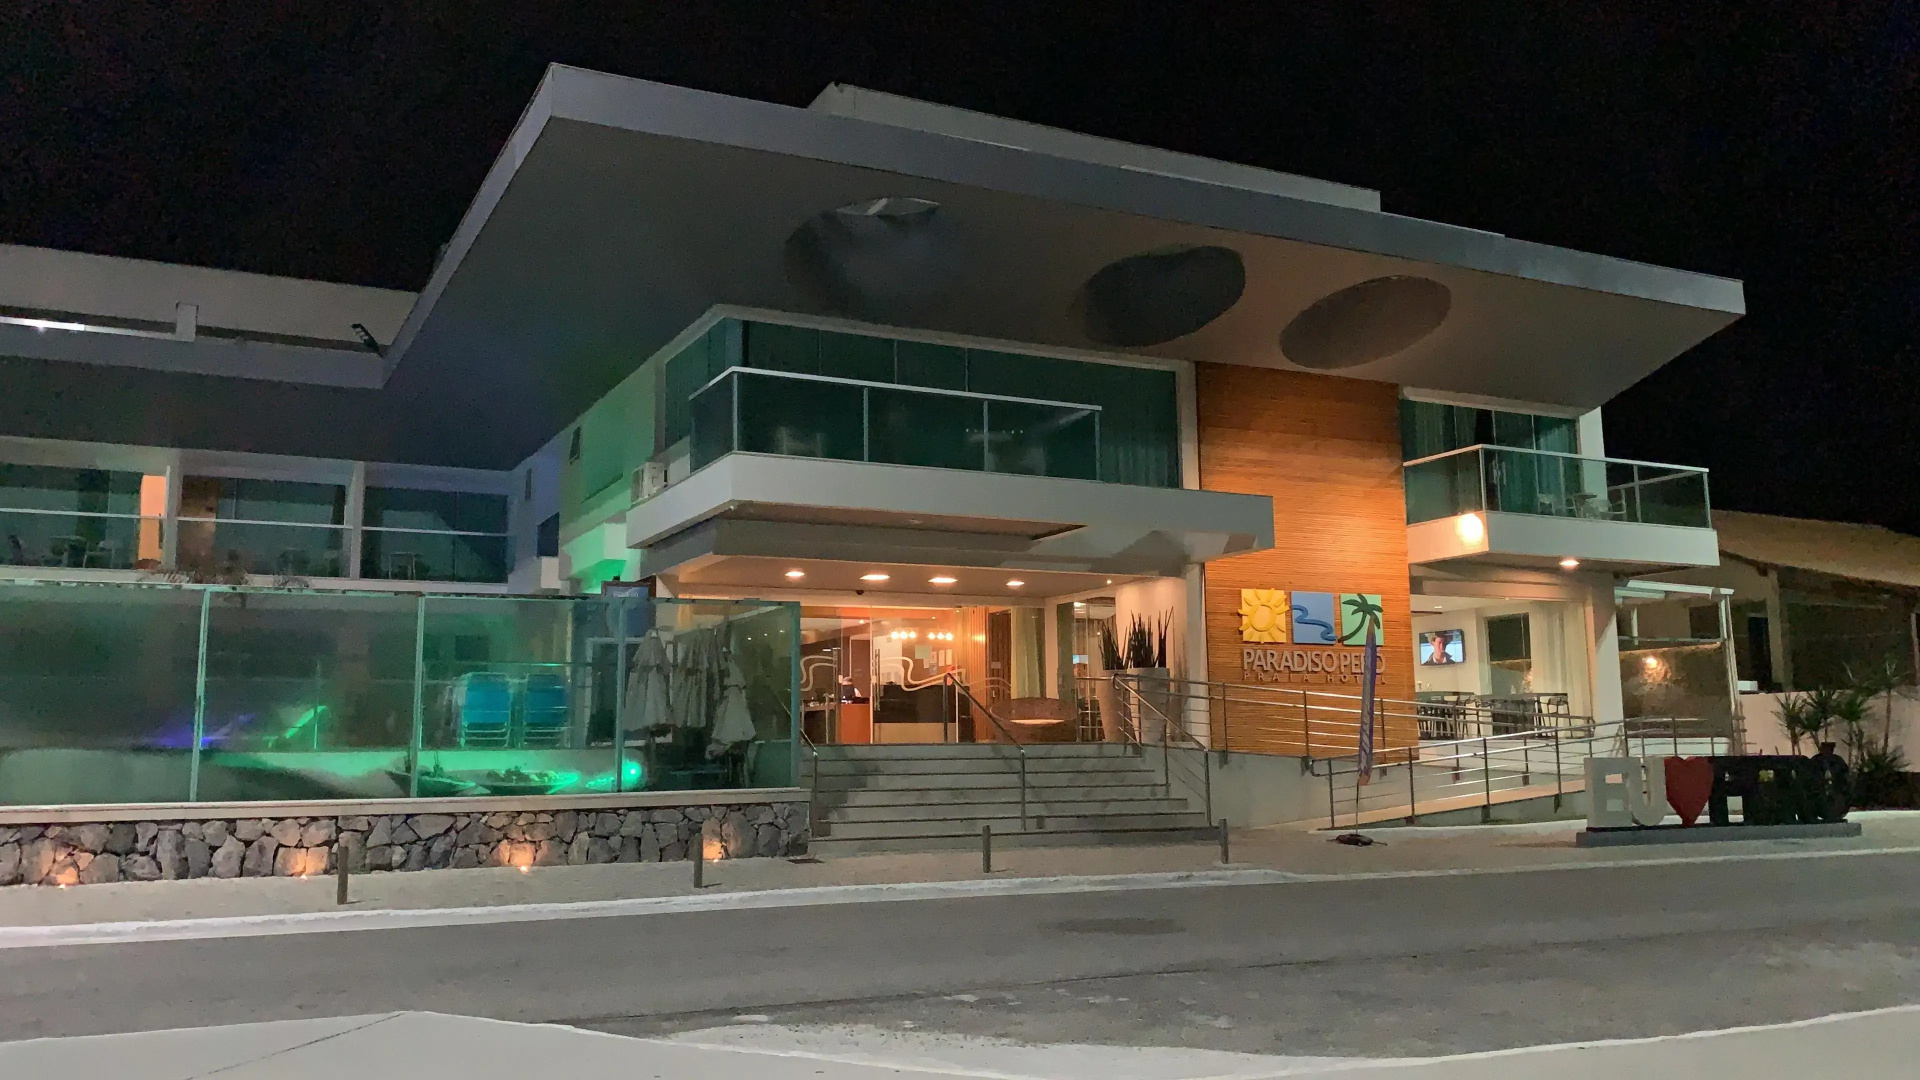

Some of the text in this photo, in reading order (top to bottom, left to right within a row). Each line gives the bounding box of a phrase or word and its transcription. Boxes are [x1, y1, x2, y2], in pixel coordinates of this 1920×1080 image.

[1243, 647, 1386, 674] PARADISO PEÓ
[1243, 671, 1386, 685] PRAIA HOTL
[1584, 756, 1666, 828] EU
